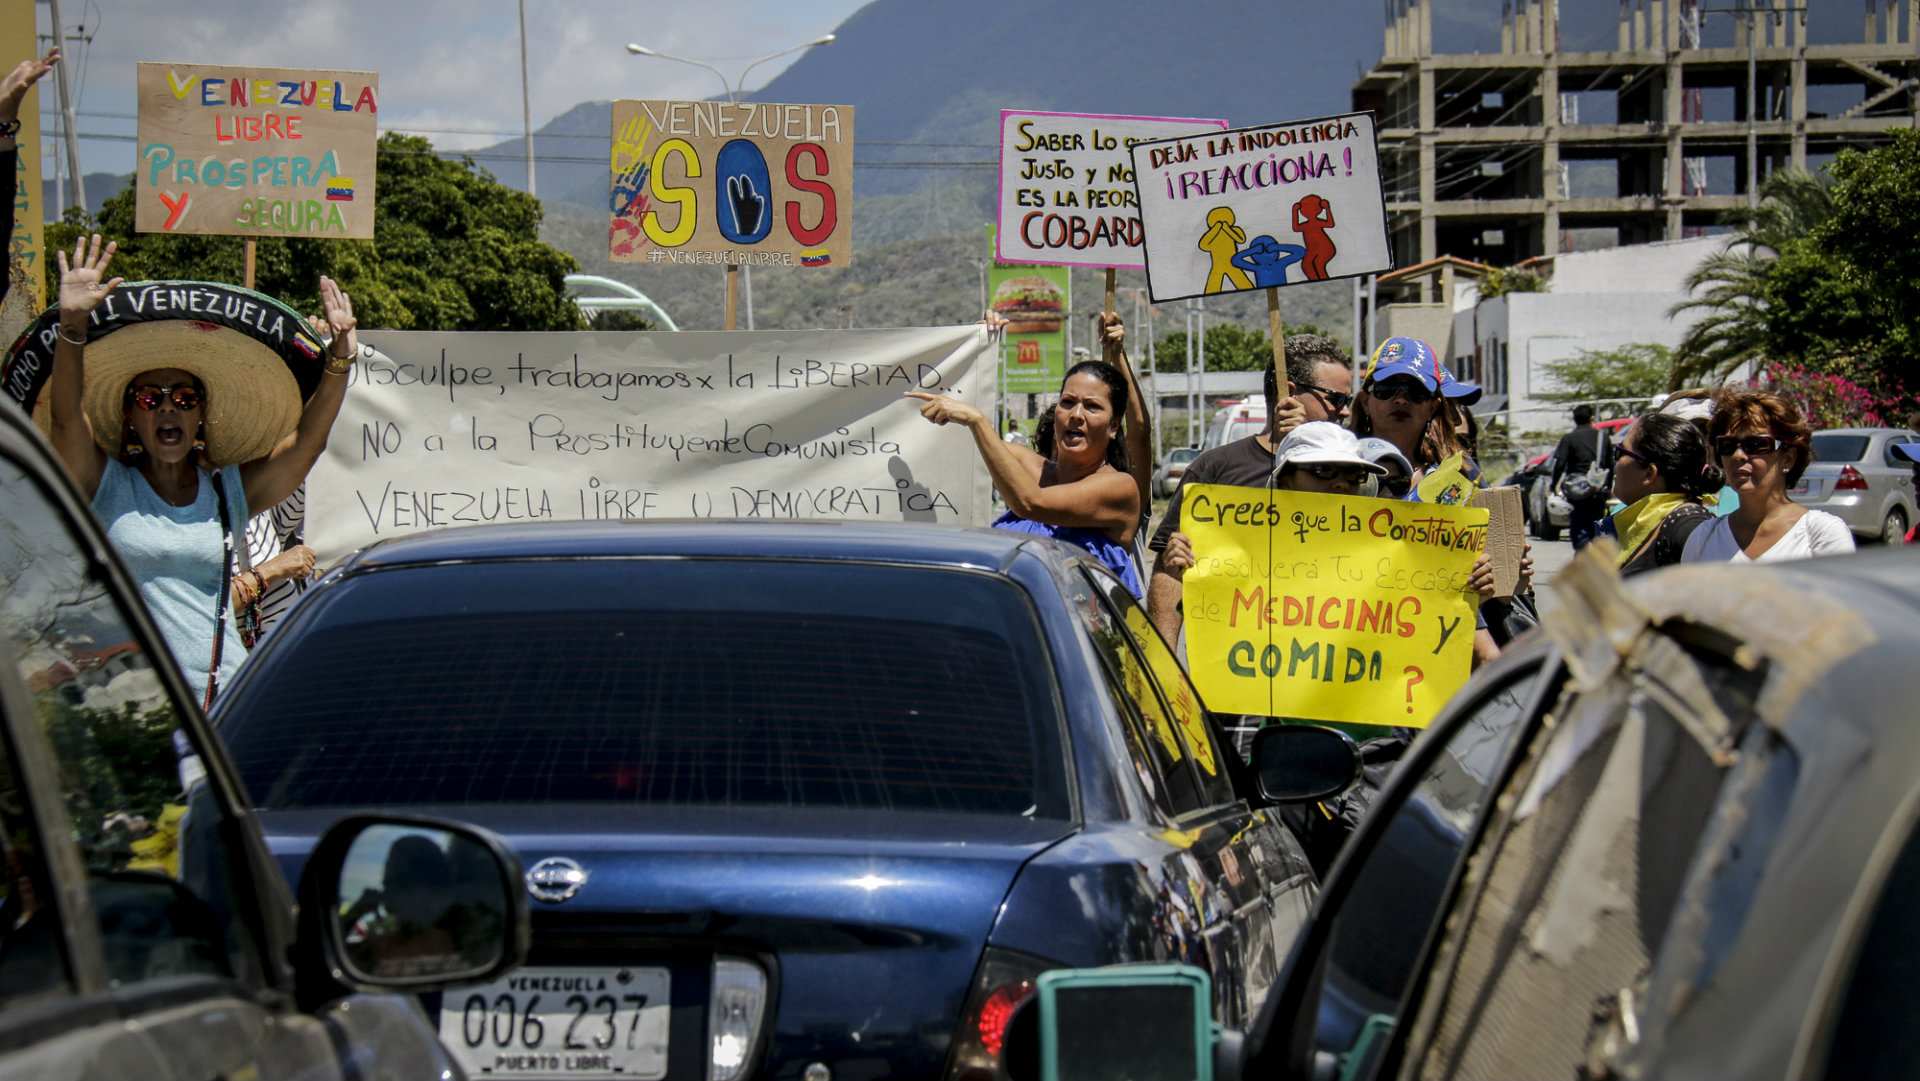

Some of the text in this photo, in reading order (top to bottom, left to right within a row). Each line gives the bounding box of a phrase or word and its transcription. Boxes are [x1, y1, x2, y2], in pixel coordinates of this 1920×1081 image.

[166, 68, 377, 113] VENEZUELA
[215, 112, 303, 144] LIBRE
[641, 101, 841, 144] VENEZUELA
[1014, 119, 1084, 152] SABER
[142, 143, 340, 188] PROSPERA
[1020, 158, 1074, 181] JUSTO
[1108, 163, 1135, 184] NO
[1149, 140, 1199, 170] DEJA
[1207, 136, 1235, 158] LA
[159, 190, 347, 233] Y SEGURA
[640, 138, 837, 247] SOS
[1016, 189, 1138, 209] ES LA PEOR
[9, 350, 40, 402] UCHO
[127, 286, 284, 344] VENEZUELA
[507, 353, 691, 401] trabajamos
[728, 354, 753, 389] la
[362, 421, 401, 461] NO
[424, 434, 444, 451] a
[472, 416, 497, 451] la
[356, 480, 552, 534] VENEZUELA
[1191, 494, 1281, 527] Crees
[1291, 511, 1330, 543] que
[1341, 505, 1361, 533] la
[1190, 593, 1221, 622] de
[1229, 585, 1422, 637] MEDICINAS
[1227, 637, 1424, 714] COMIDA ?
[508, 977, 606, 992] VENEZUELA
[464, 992, 648, 1050] 006 237
[496, 1055, 613, 1071] PUERTO LIBRE
